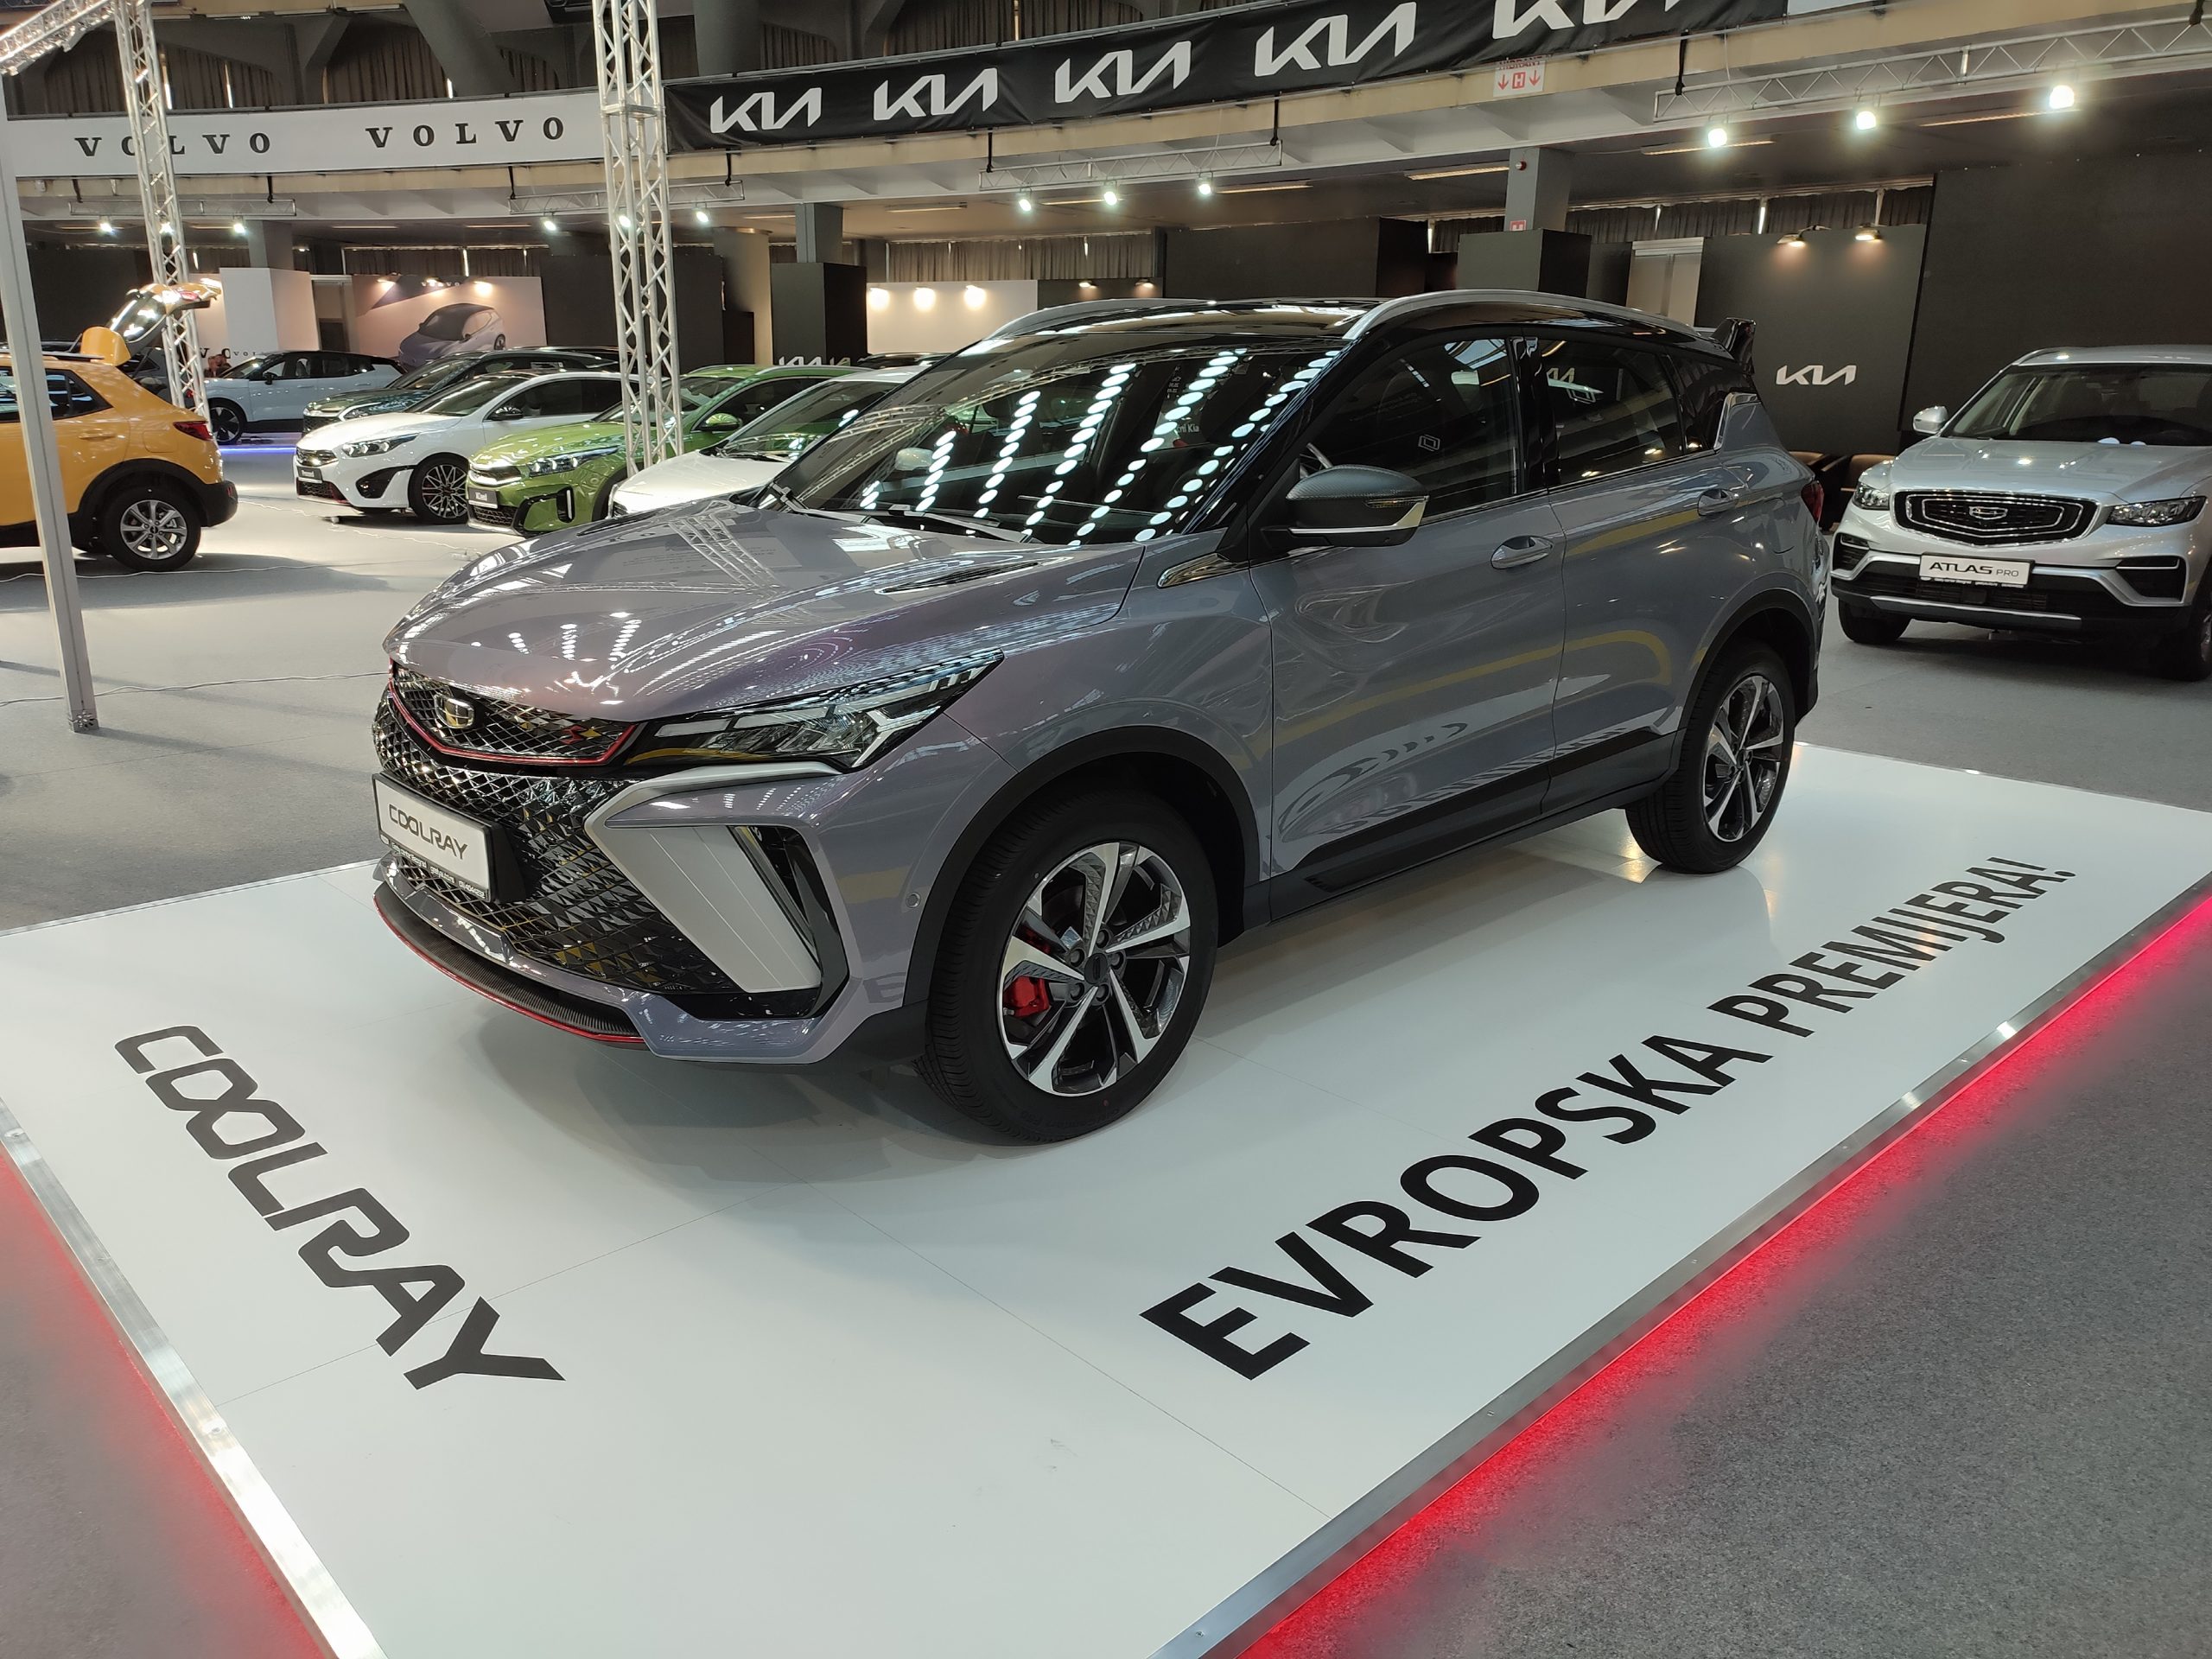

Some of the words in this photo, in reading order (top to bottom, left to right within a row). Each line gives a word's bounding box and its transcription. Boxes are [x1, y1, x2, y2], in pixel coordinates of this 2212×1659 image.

[1255, 2, 1416, 77] KIA
[874, 67, 998, 121] KIA
[1055, 41, 1192, 104] KIA
[365, 117, 564, 148] VOLVO
[710, 87, 822, 134] KIA
[74, 133, 270, 156] VOLVO
[1776, 365, 1857, 385] KIA
[1929, 562, 1993, 575] ATLAS
[389, 804, 468, 859] COOLRAY
[1139, 1035, 1773, 1381] EVROPSKA
[1707, 856, 2076, 1038] PREMIJERA!
[114, 1025, 567, 1390] COOLRAY
